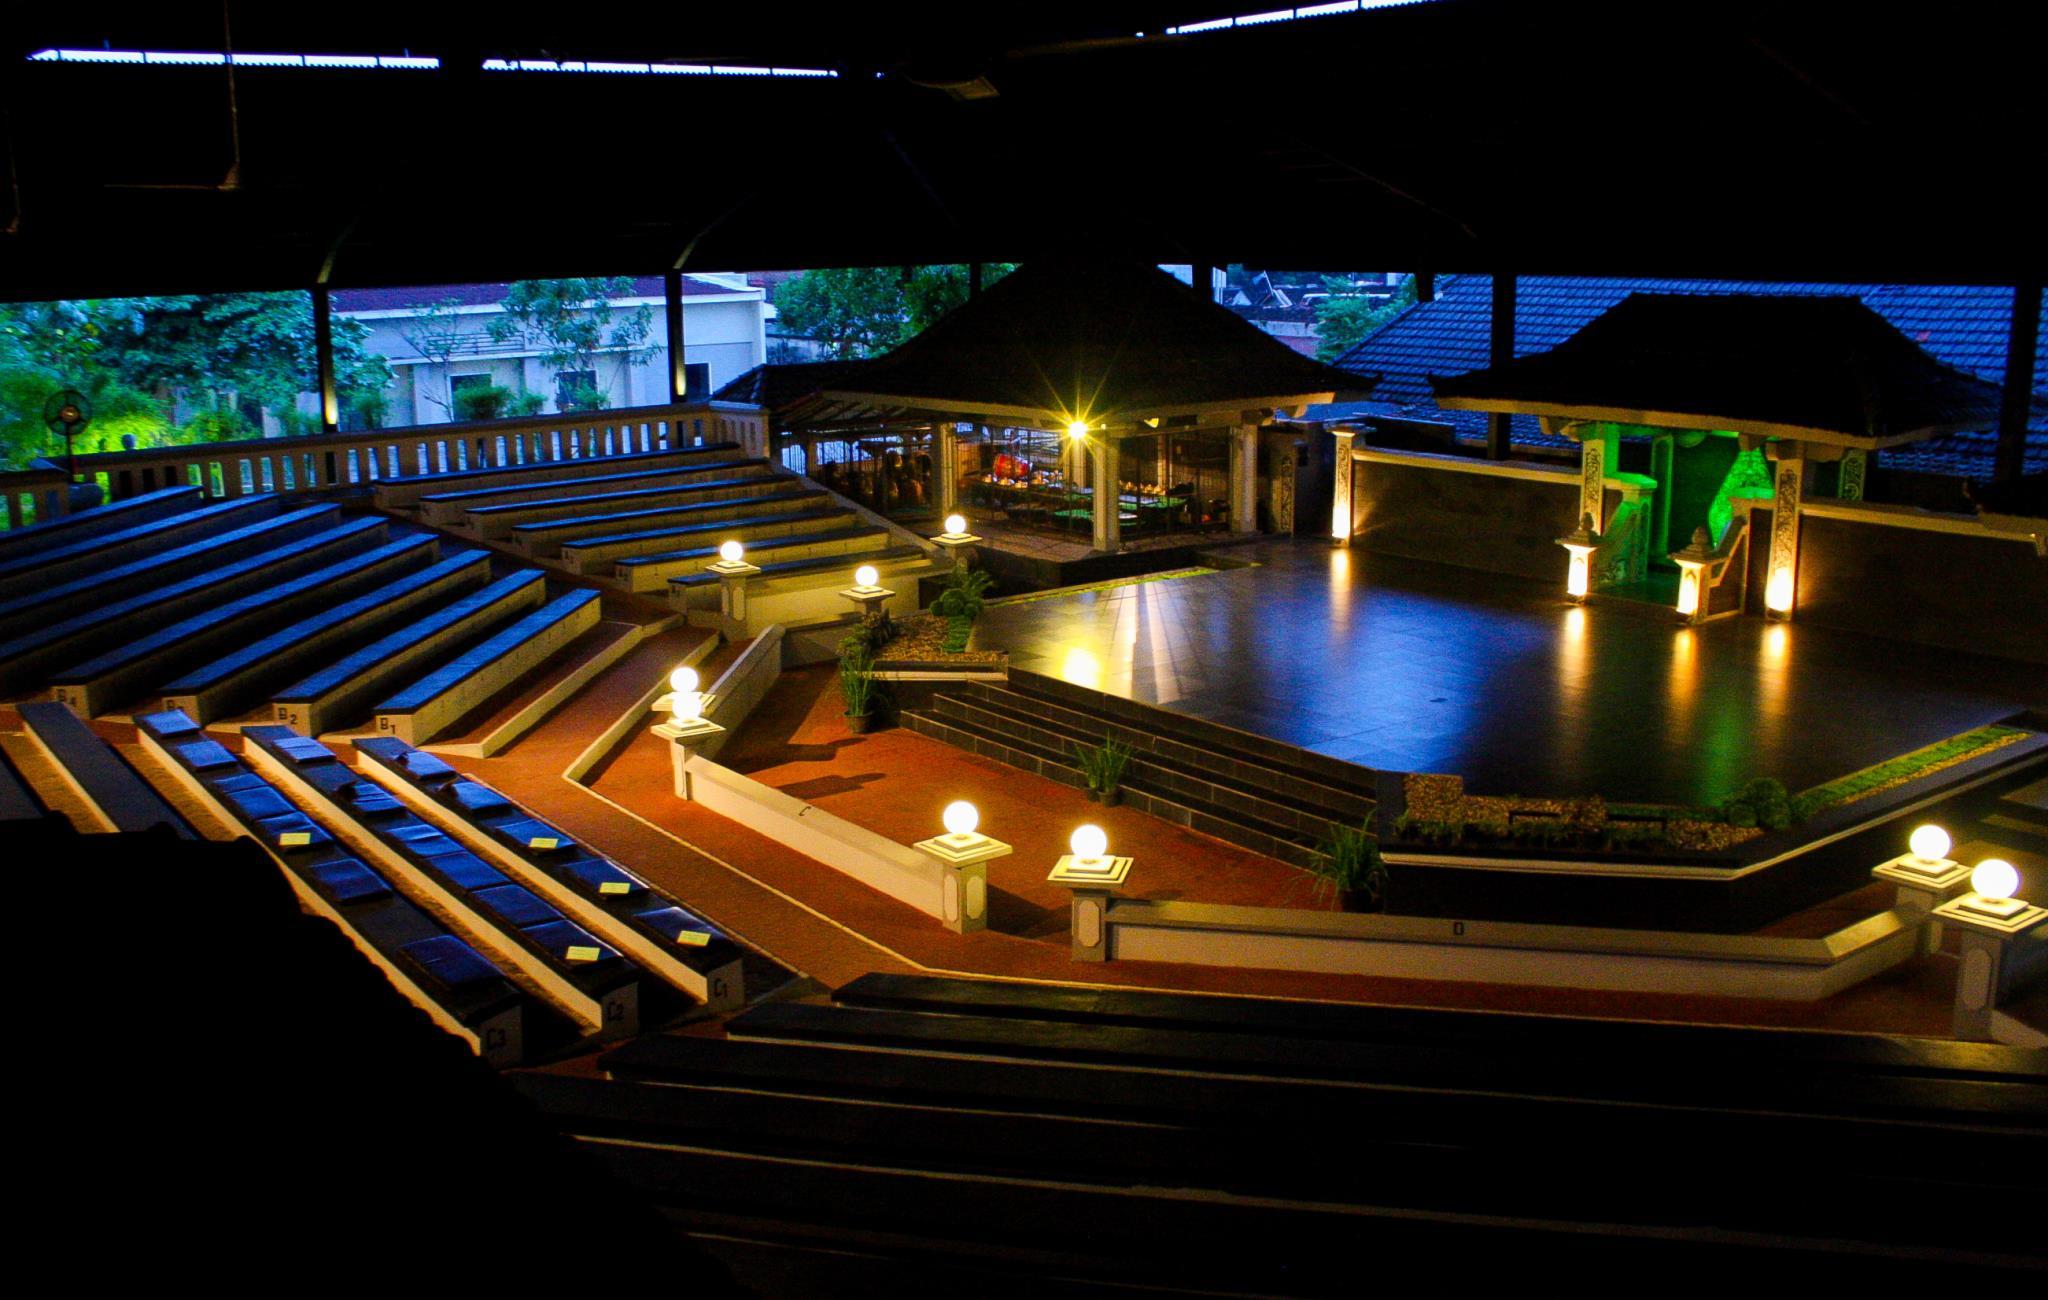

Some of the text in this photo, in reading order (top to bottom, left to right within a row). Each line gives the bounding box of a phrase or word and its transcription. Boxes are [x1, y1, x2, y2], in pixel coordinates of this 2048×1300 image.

[278, 707, 298, 725] B2
[380, 717, 396, 735] B1
[799, 806, 811, 816] C
[714, 978, 728, 998] C1
[608, 1001, 624, 1021] C2
[487, 1028, 506, 1050] C3
